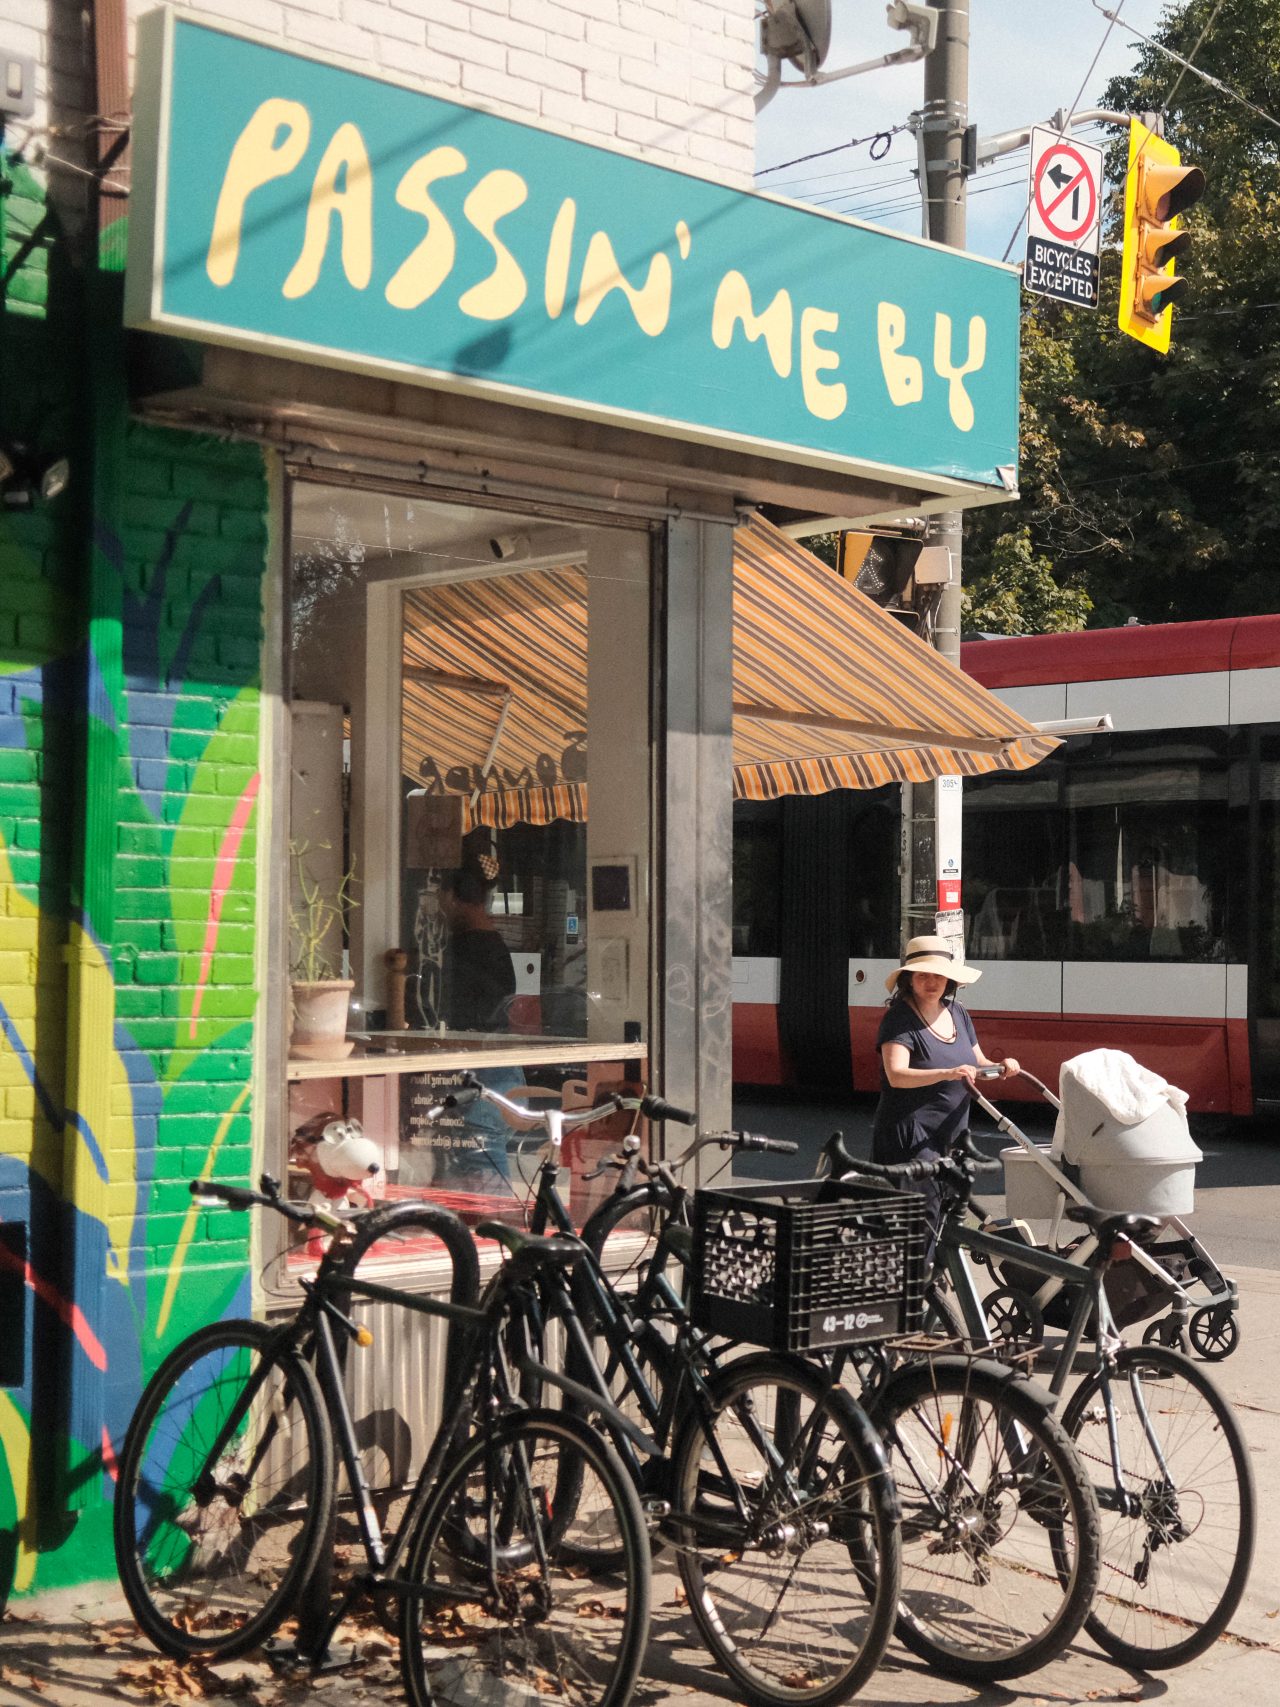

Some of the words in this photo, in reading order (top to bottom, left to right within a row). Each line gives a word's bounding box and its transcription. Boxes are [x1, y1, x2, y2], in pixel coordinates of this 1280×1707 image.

[204, 98, 692, 337] PASSIN'
[711, 270, 848, 420] ME
[877, 301, 987, 432] BY
[1035, 244, 1092, 276] BICYCLES
[1031, 266, 1094, 299] EXCEPTED
